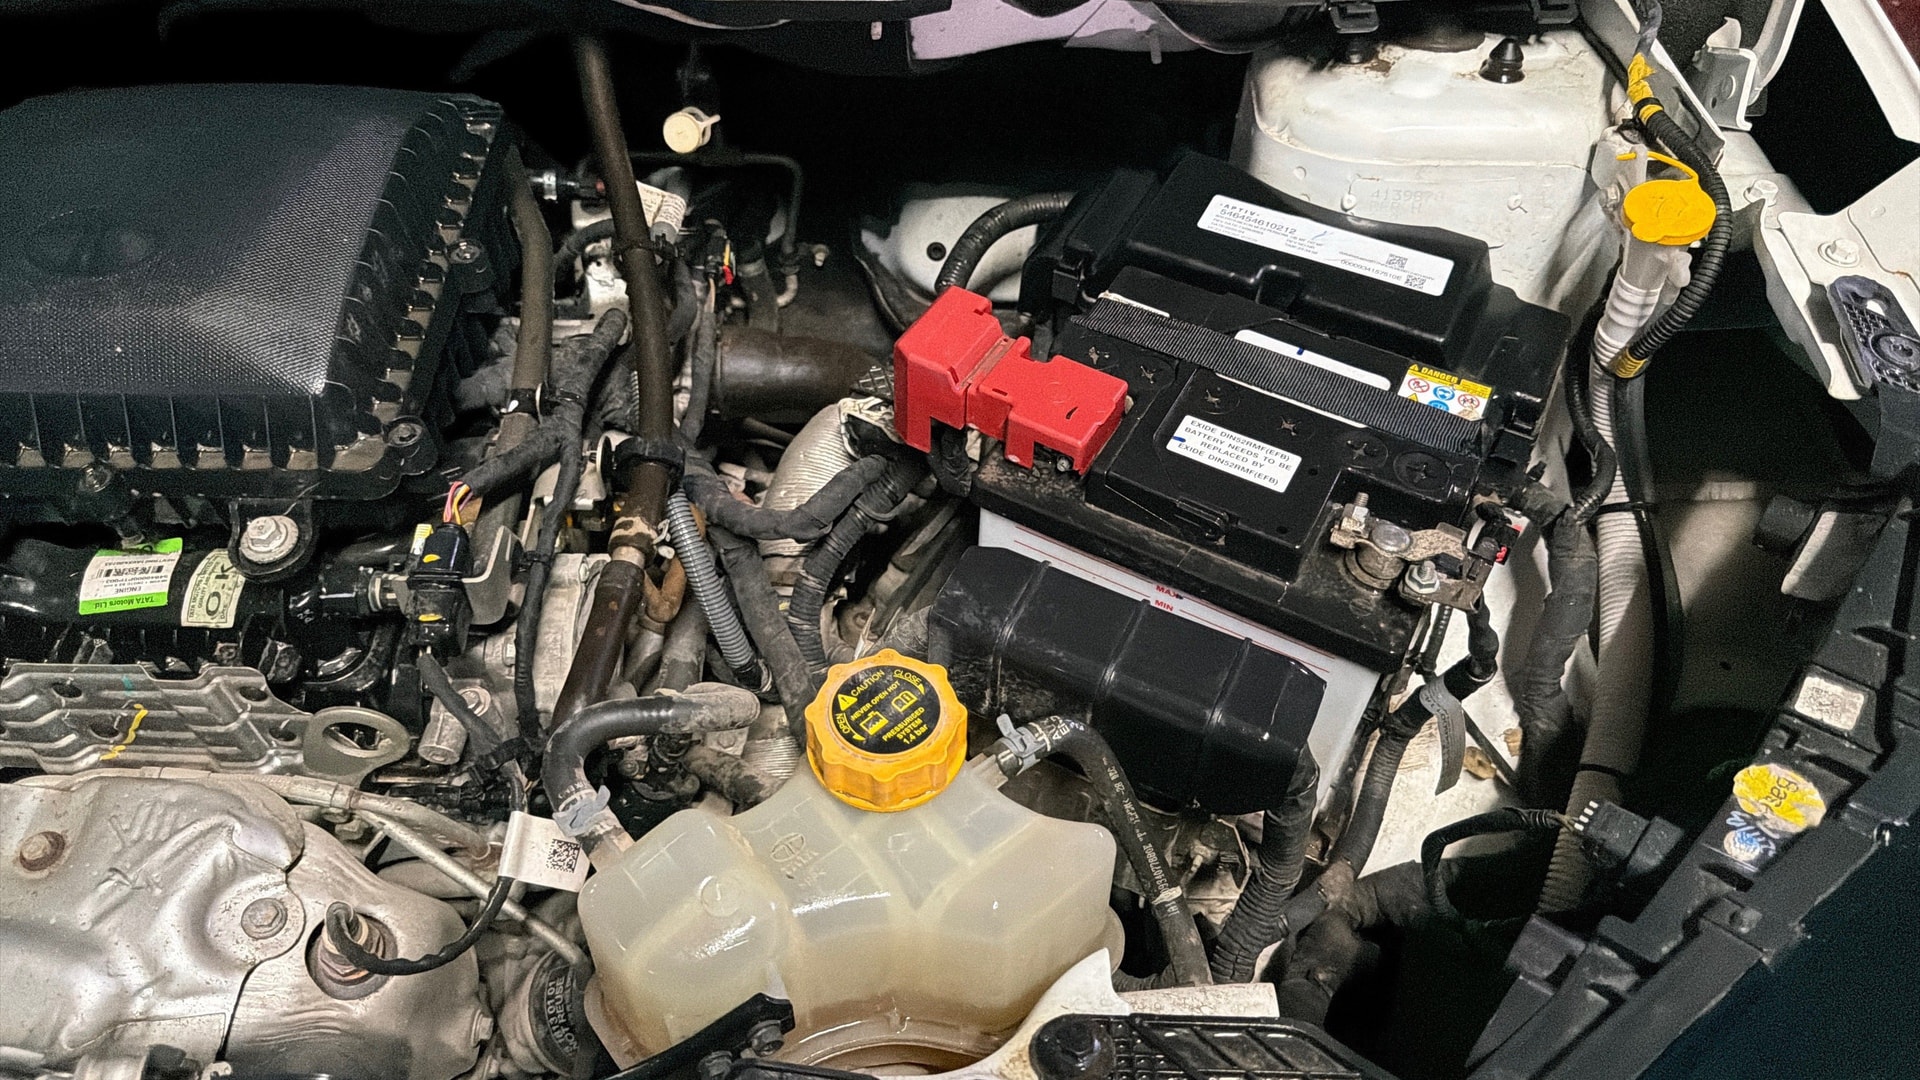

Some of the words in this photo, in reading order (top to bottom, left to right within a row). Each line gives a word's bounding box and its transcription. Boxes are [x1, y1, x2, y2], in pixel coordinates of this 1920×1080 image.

[1224, 204, 1256, 216] APTIV
[1219, 209, 1297, 235] 546454610212
[1421, 367, 1459, 384] DANGER
[1184, 427, 1225, 446] BATTERY
[1228, 443, 1260, 459] NEEDS
[1263, 456, 1275, 465] TO
[1278, 461, 1292, 471] BE
[1190, 420, 1218, 434] EXIDE
[1220, 431, 1290, 462] DIN52RMF(EFB)
[1178, 443, 1206, 457] EXIDE
[1208, 454, 1279, 486] DIN52RMF(EFB)
[1200, 441, 1249, 463] REPLACED
[1251, 459, 1265, 469] BY
[109, 598, 135, 606] Motors
[135, 595, 155, 604] TATA
[1156, 585, 1179, 599] MAX
[94, 600, 108, 609] Ltd
[1155, 600, 1173, 611] MIN
[850, 669, 886, 697] CAUTION
[893, 669, 922, 685] CLOSE
[851, 702, 873, 722] NEVER
[872, 691, 889, 705] OPEN
[887, 681, 901, 696] HOT
[836, 713, 851, 734] OPEN
[882, 706, 925, 742] PRESSURISED
[897, 718, 923, 739] SYSTEM
[903, 733, 916, 745] 1.4
[915, 724, 929, 737] bar
[555, 975, 567, 1023] REUSE
[560, 1026, 579, 1050] NOT
